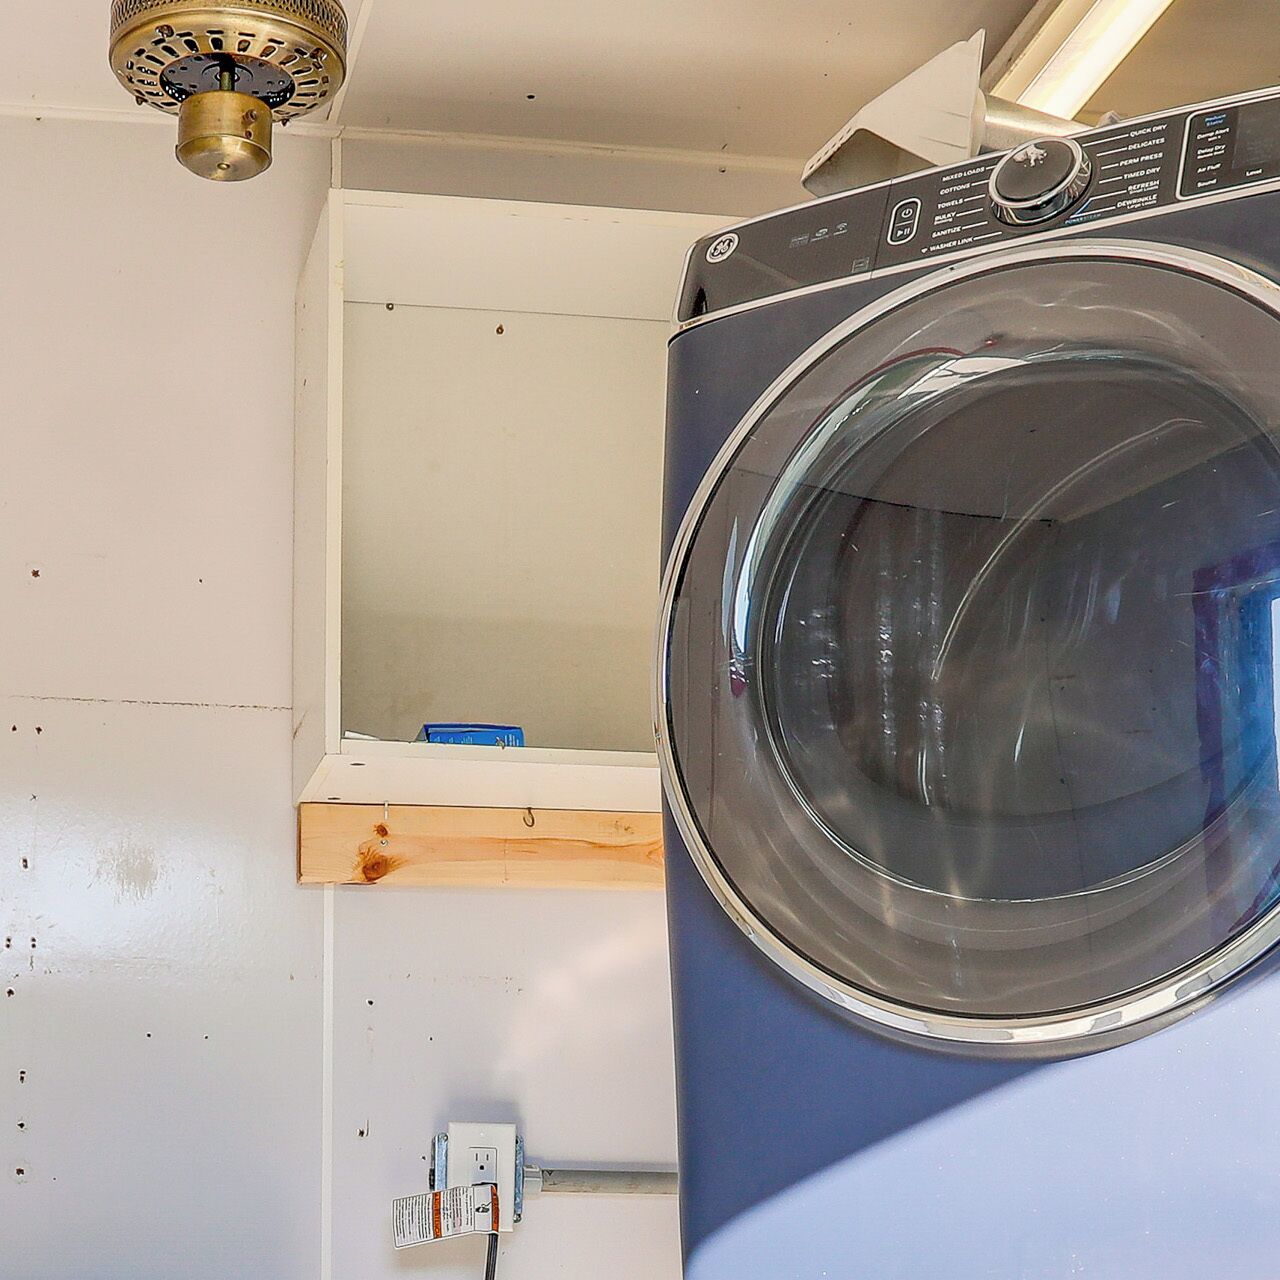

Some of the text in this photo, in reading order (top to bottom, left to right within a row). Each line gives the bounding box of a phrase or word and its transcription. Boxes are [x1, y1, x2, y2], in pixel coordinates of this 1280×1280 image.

[1130, 124, 1168, 137] QUICK DRY
[1197, 131, 1215, 140] Damp
[1215, 127, 1230, 136] Alert
[1128, 137, 1165, 150] DELICATES
[1197, 146, 1214, 155] Delay
[1215, 144, 1226, 152] Dry
[1120, 152, 1163, 166] PERM PRESS
[1207, 162, 1222, 171] Fluff
[1246, 168, 1263, 177] Level
[942, 166, 985, 181] MIXED LOADS
[1123, 167, 1161, 180] TIMED DRY
[940, 183, 971, 195] COTTONS
[1128, 180, 1160, 191] REFRESH
[1197, 179, 1217, 188] Sound
[938, 198, 963, 209] TOWELS
[1117, 194, 1158, 208] DEWRINKLE
[935, 211, 956, 221] BULKY
[932, 226, 962, 238] SANITIZE
[930, 236, 973, 251] WASHER LINK
